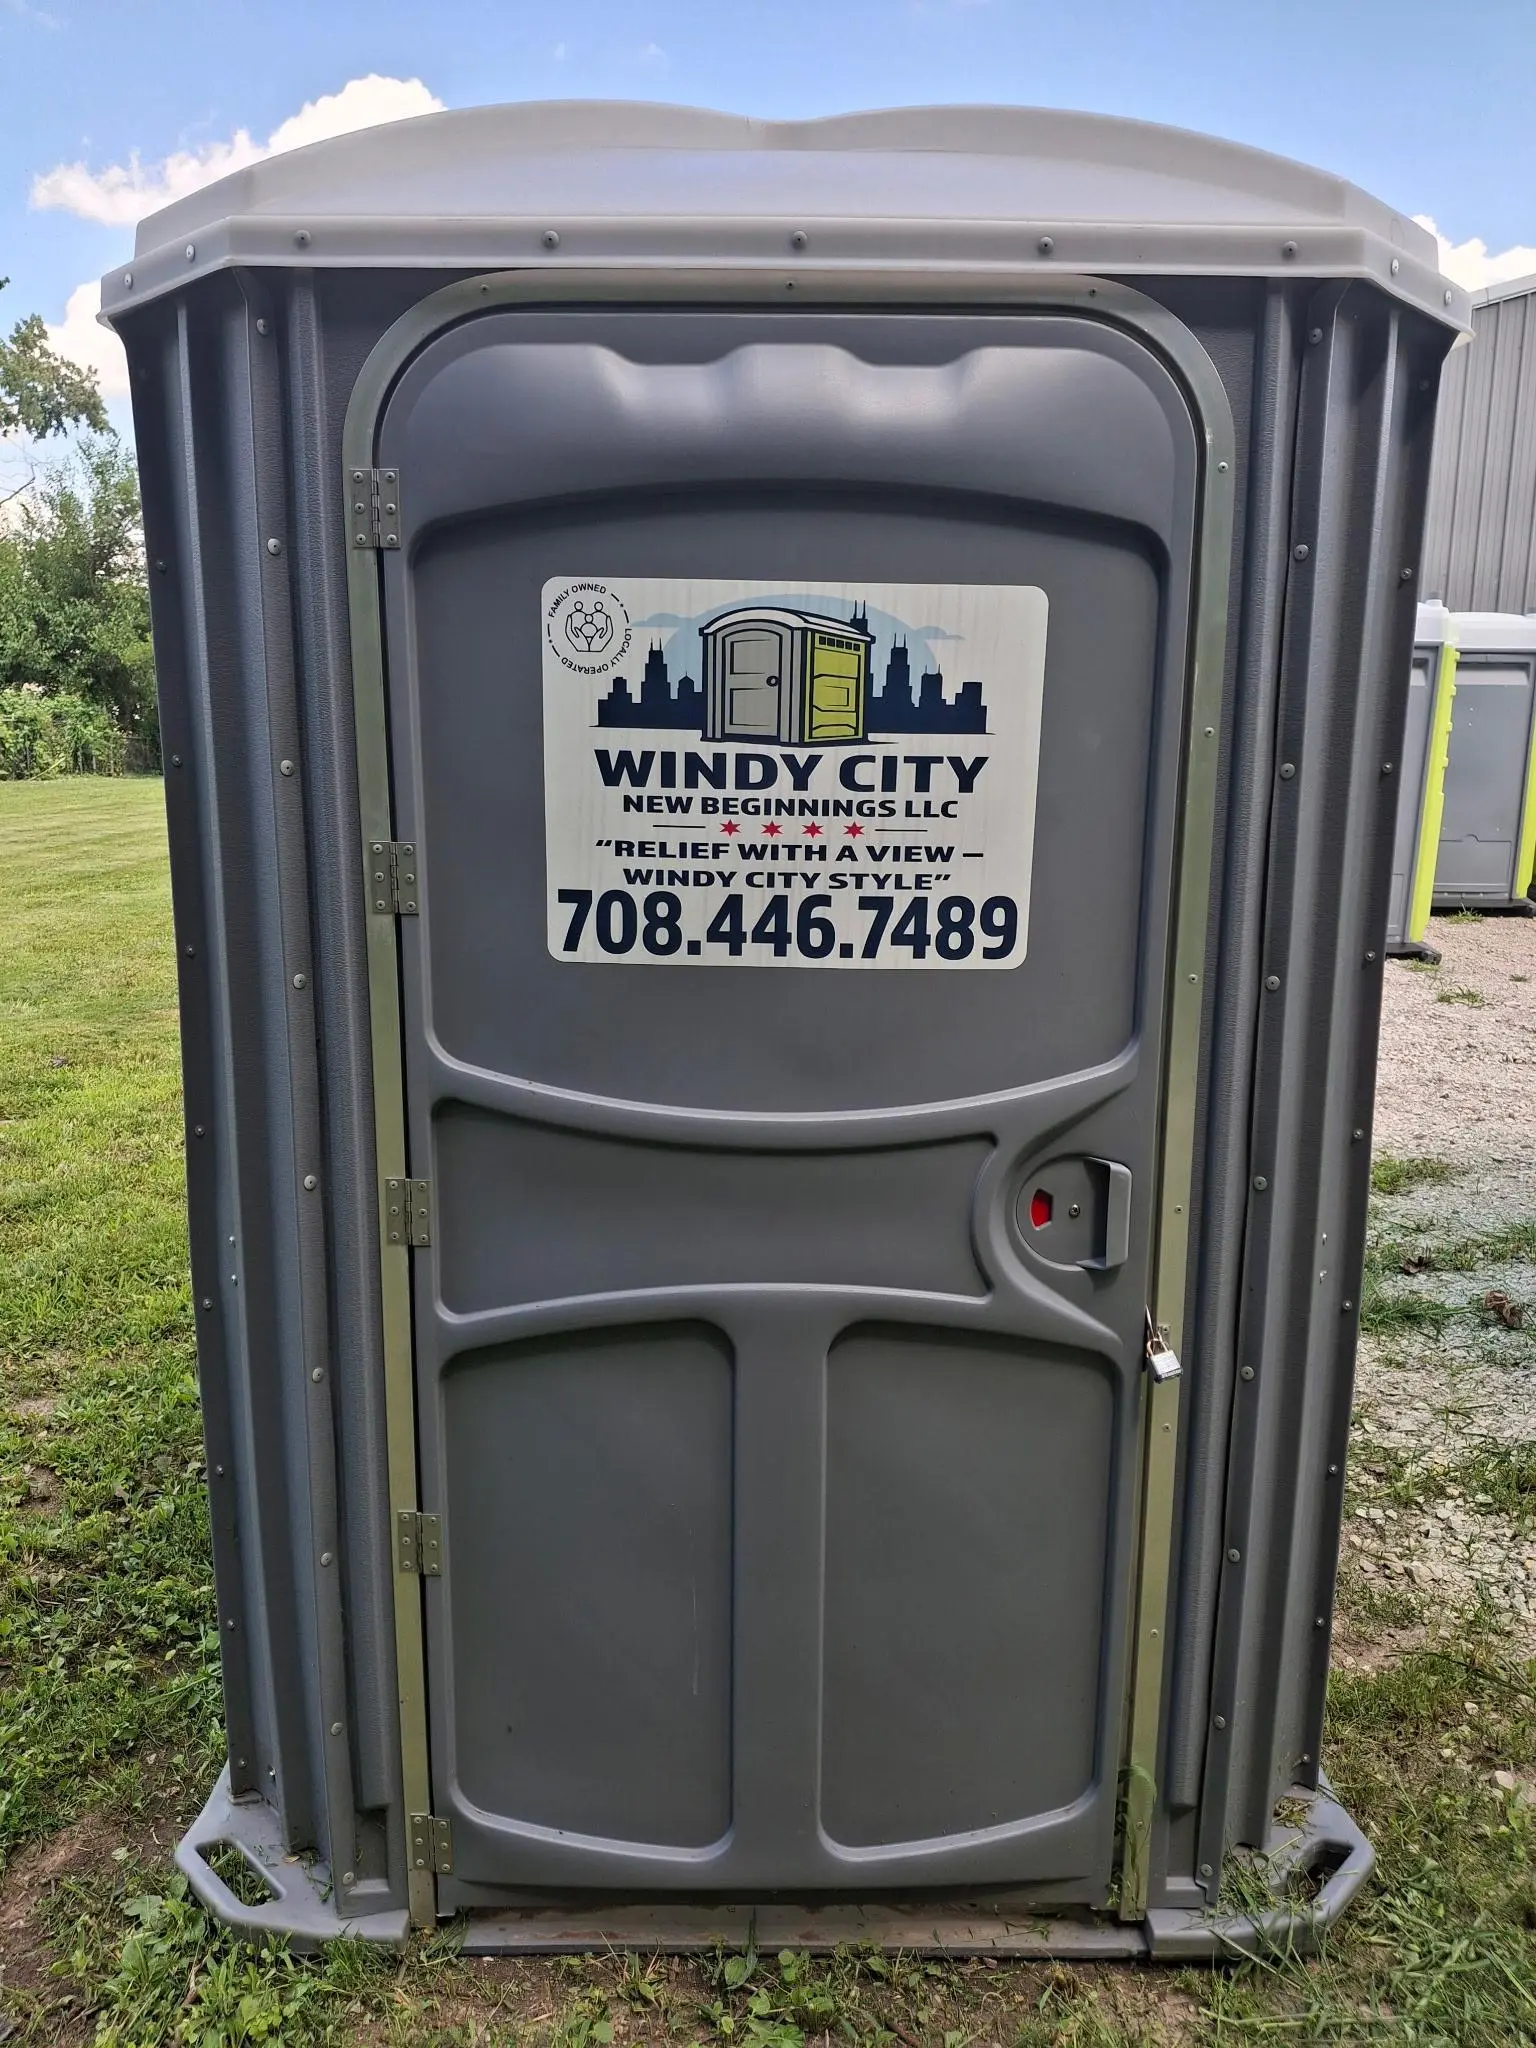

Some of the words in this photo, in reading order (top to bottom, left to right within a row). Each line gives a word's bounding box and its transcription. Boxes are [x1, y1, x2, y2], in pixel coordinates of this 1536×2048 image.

[548, 589, 570, 617] FAMILY
[571, 583, 607, 594] OWNED
[610, 628, 632, 667] LOCALLY
[561, 657, 609, 675] OPERATED
[594, 749, 823, 791] WINDY
[839, 755, 989, 793] CITY
[623, 795, 693, 814] NEW
[701, 797, 896, 818] BEGINNINGS
[904, 800, 958, 818] LLC
[737, 843, 827, 862] WITH
[835, 845, 859, 862] A
[866, 845, 955, 863] VIEW
[623, 868, 737, 887] WINDY
[746, 871, 821, 889] CITY
[557, 889, 1018, 961] 708.446.7489
